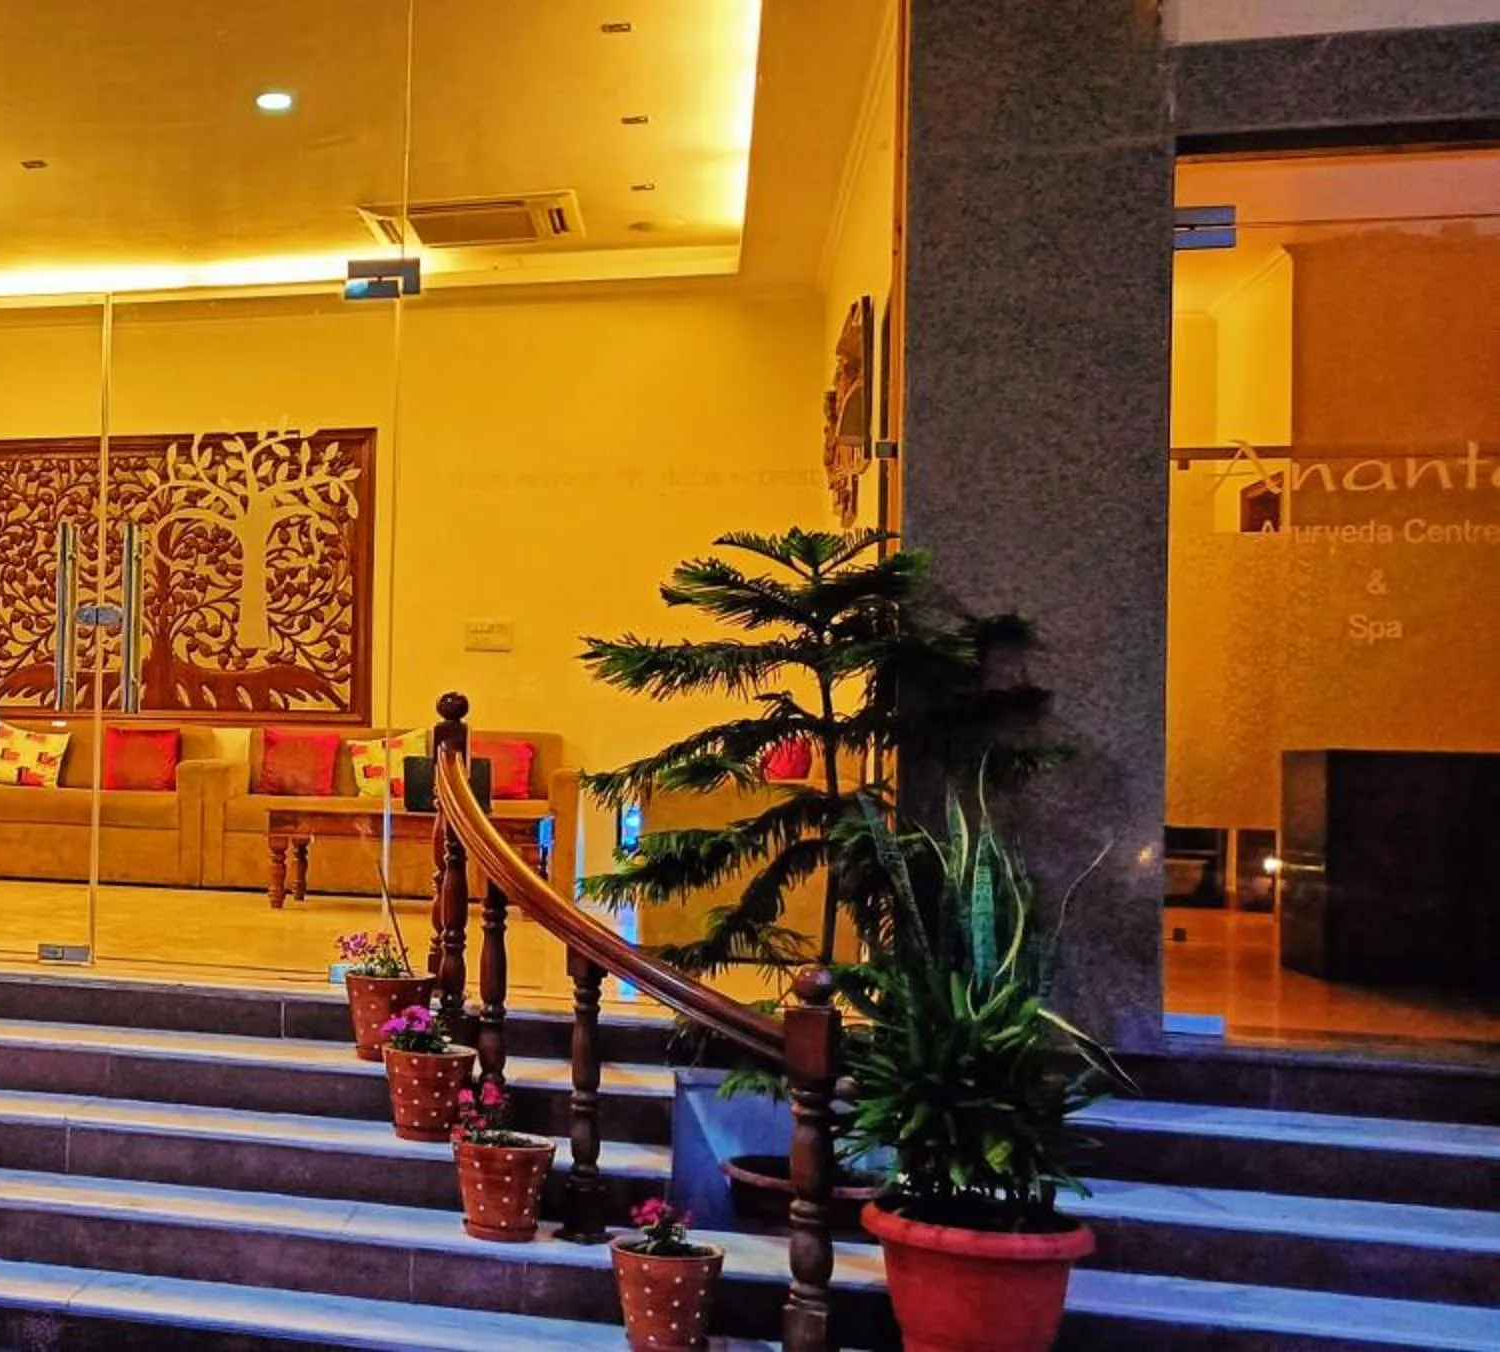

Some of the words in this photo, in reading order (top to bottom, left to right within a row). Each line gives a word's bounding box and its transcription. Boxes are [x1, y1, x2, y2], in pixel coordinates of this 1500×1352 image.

[1204, 439, 1500, 494] Anant
[1258, 518, 1393, 546] Aurveda
[1404, 518, 1500, 543] Centre
[1366, 568, 1389, 595] &
[1348, 613, 1403, 644] Spa
